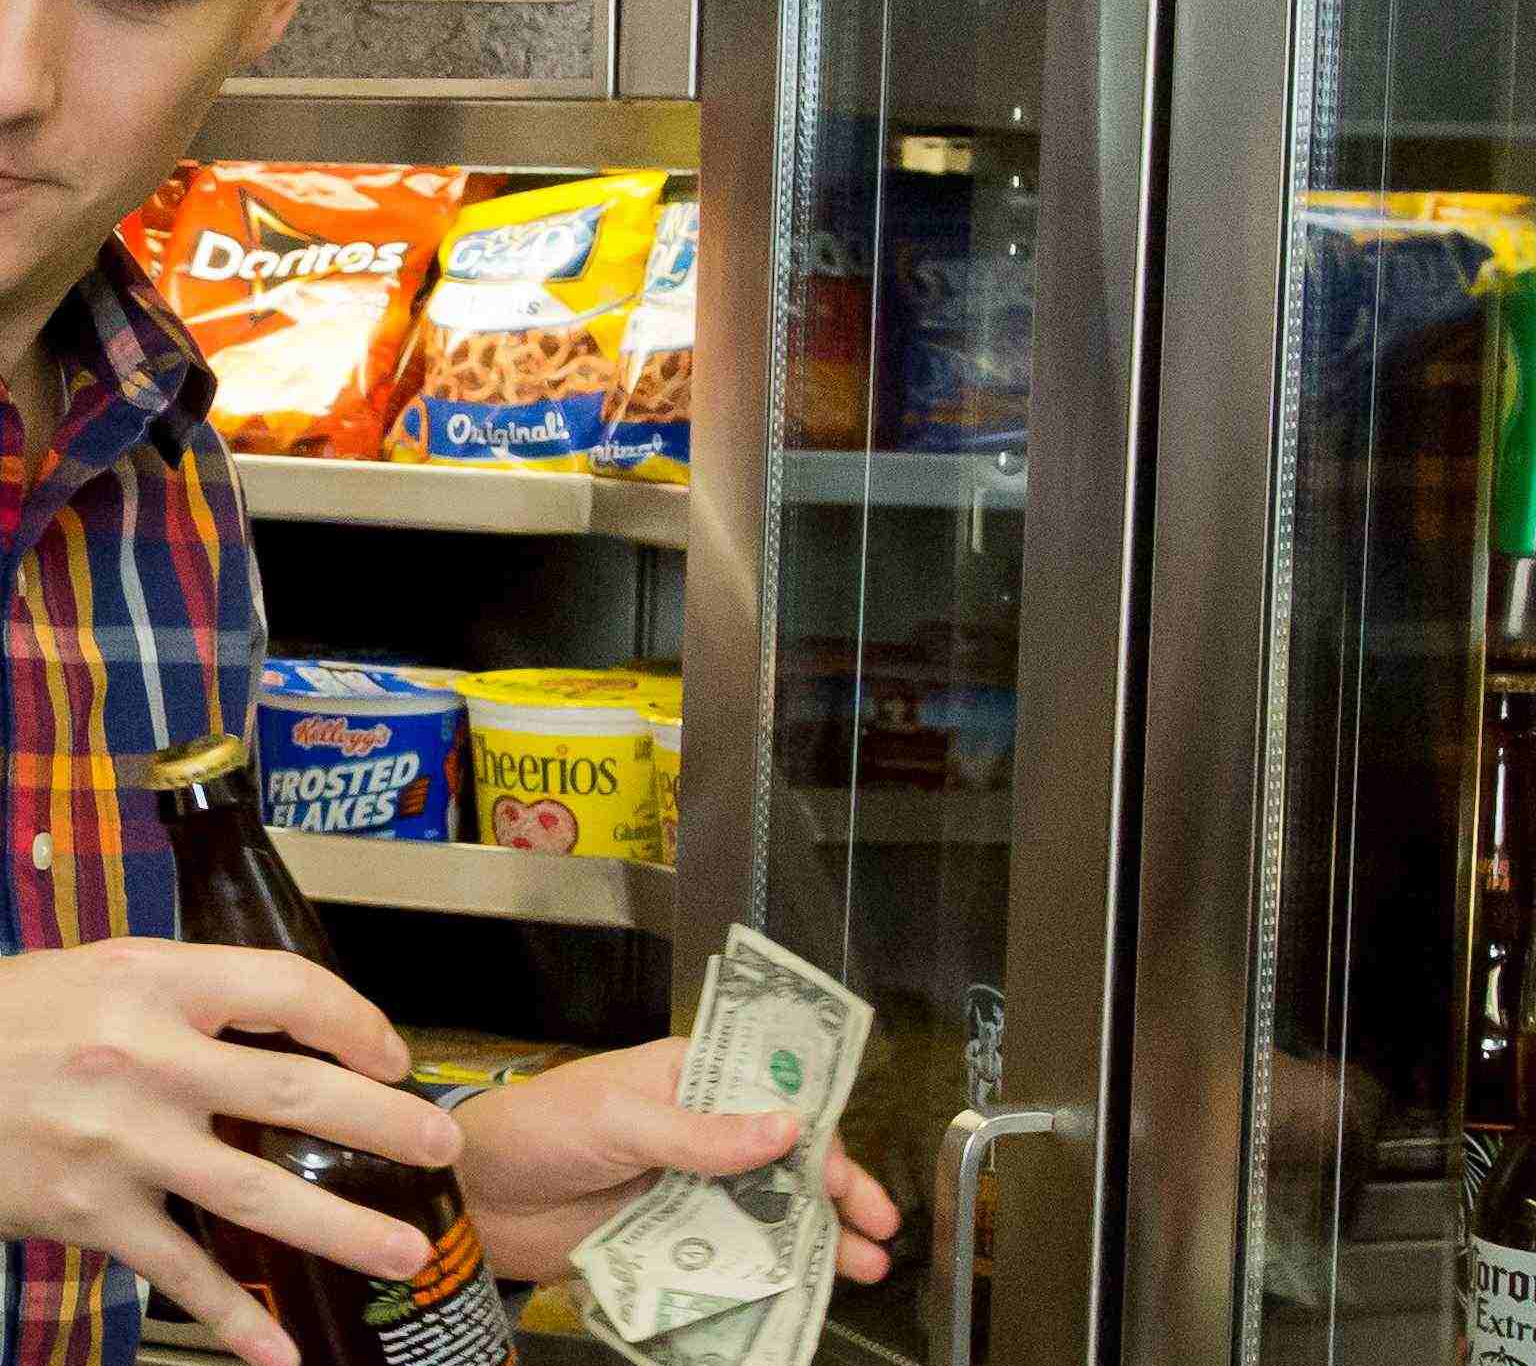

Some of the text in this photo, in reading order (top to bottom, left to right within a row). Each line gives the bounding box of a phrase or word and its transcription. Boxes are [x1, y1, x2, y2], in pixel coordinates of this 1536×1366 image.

[188, 227, 410, 283] Doritos
[292, 716, 392, 756] Kellogg's
[267, 751, 420, 805] FROSTED
